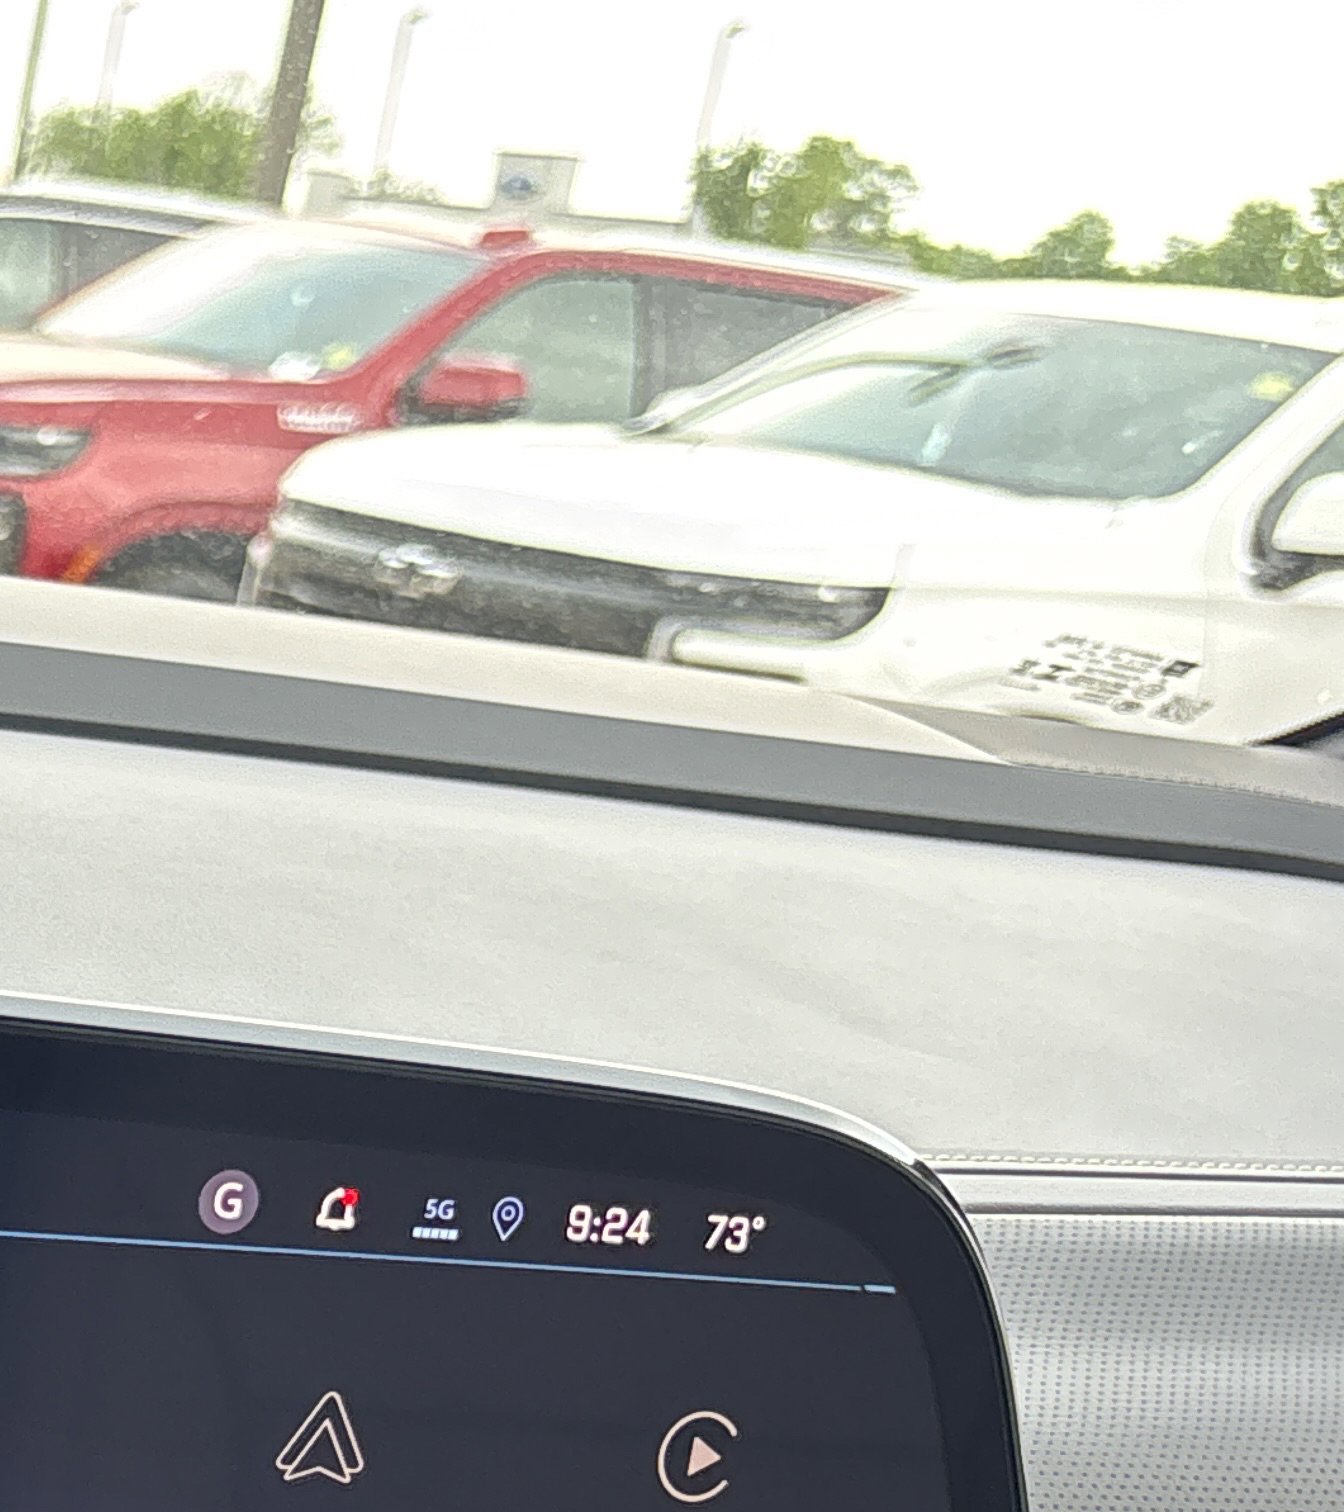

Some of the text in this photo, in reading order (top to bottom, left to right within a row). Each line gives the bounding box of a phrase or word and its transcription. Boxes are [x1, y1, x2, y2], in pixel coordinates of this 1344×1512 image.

[212, 1180, 245, 1221] G
[422, 1197, 456, 1221] 5G
[565, 1203, 652, 1246] 9:24
[704, 1213, 767, 1254] 73°
